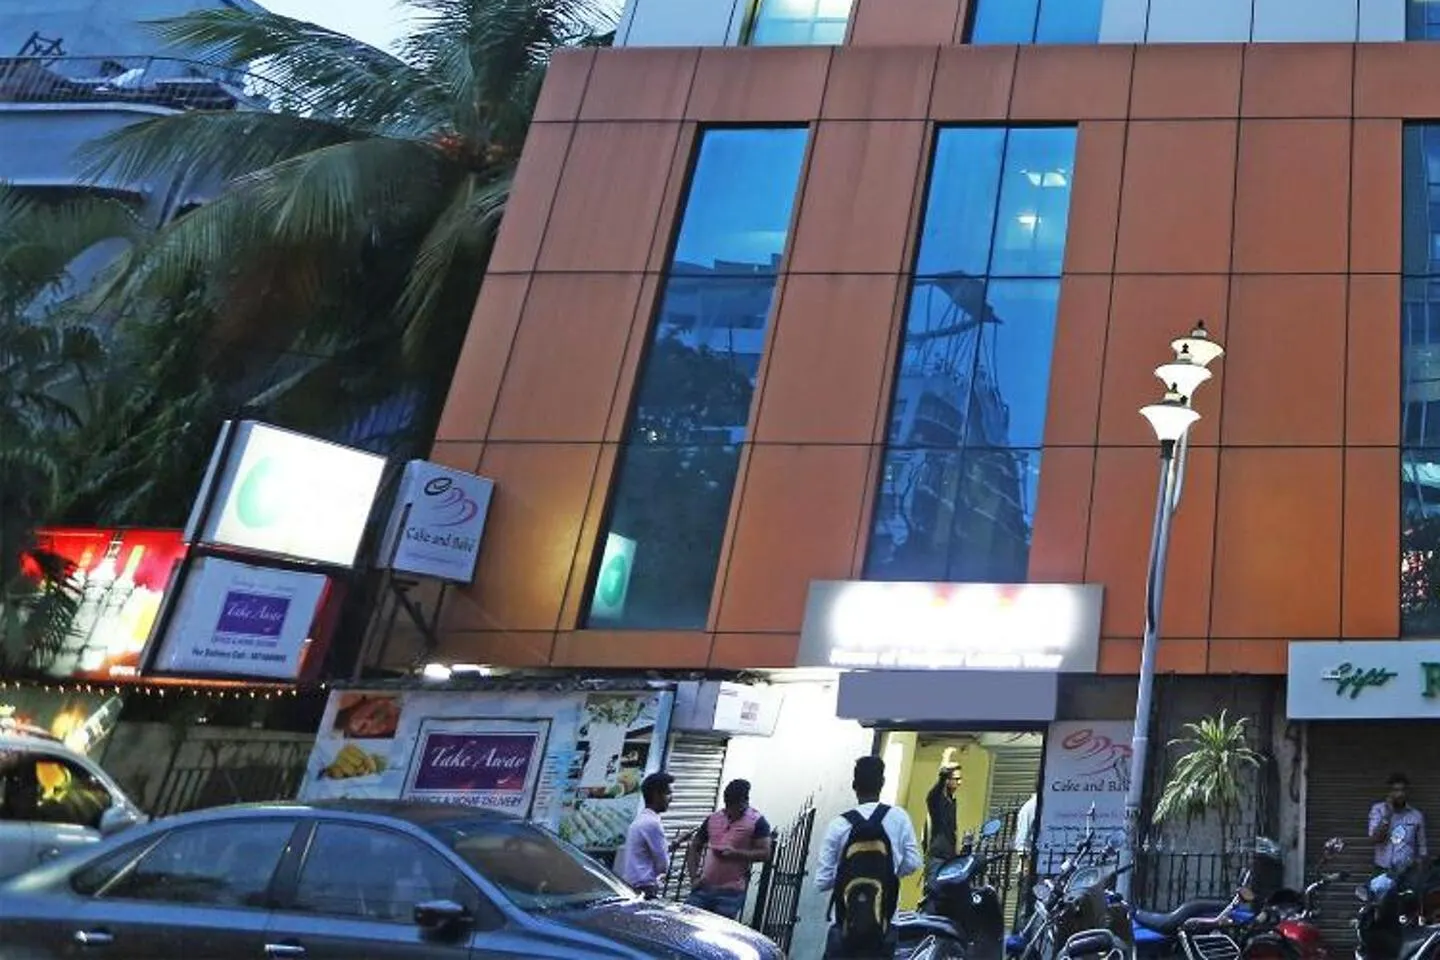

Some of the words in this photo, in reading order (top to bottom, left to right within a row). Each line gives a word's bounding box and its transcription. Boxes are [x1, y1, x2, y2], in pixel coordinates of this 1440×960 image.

[430, 744, 471, 768] Take
[473, 747, 525, 770] Away
[1051, 779, 1081, 792] Cake
[1084, 779, 1105, 792] and
[1108, 779, 1131, 792] Bak
